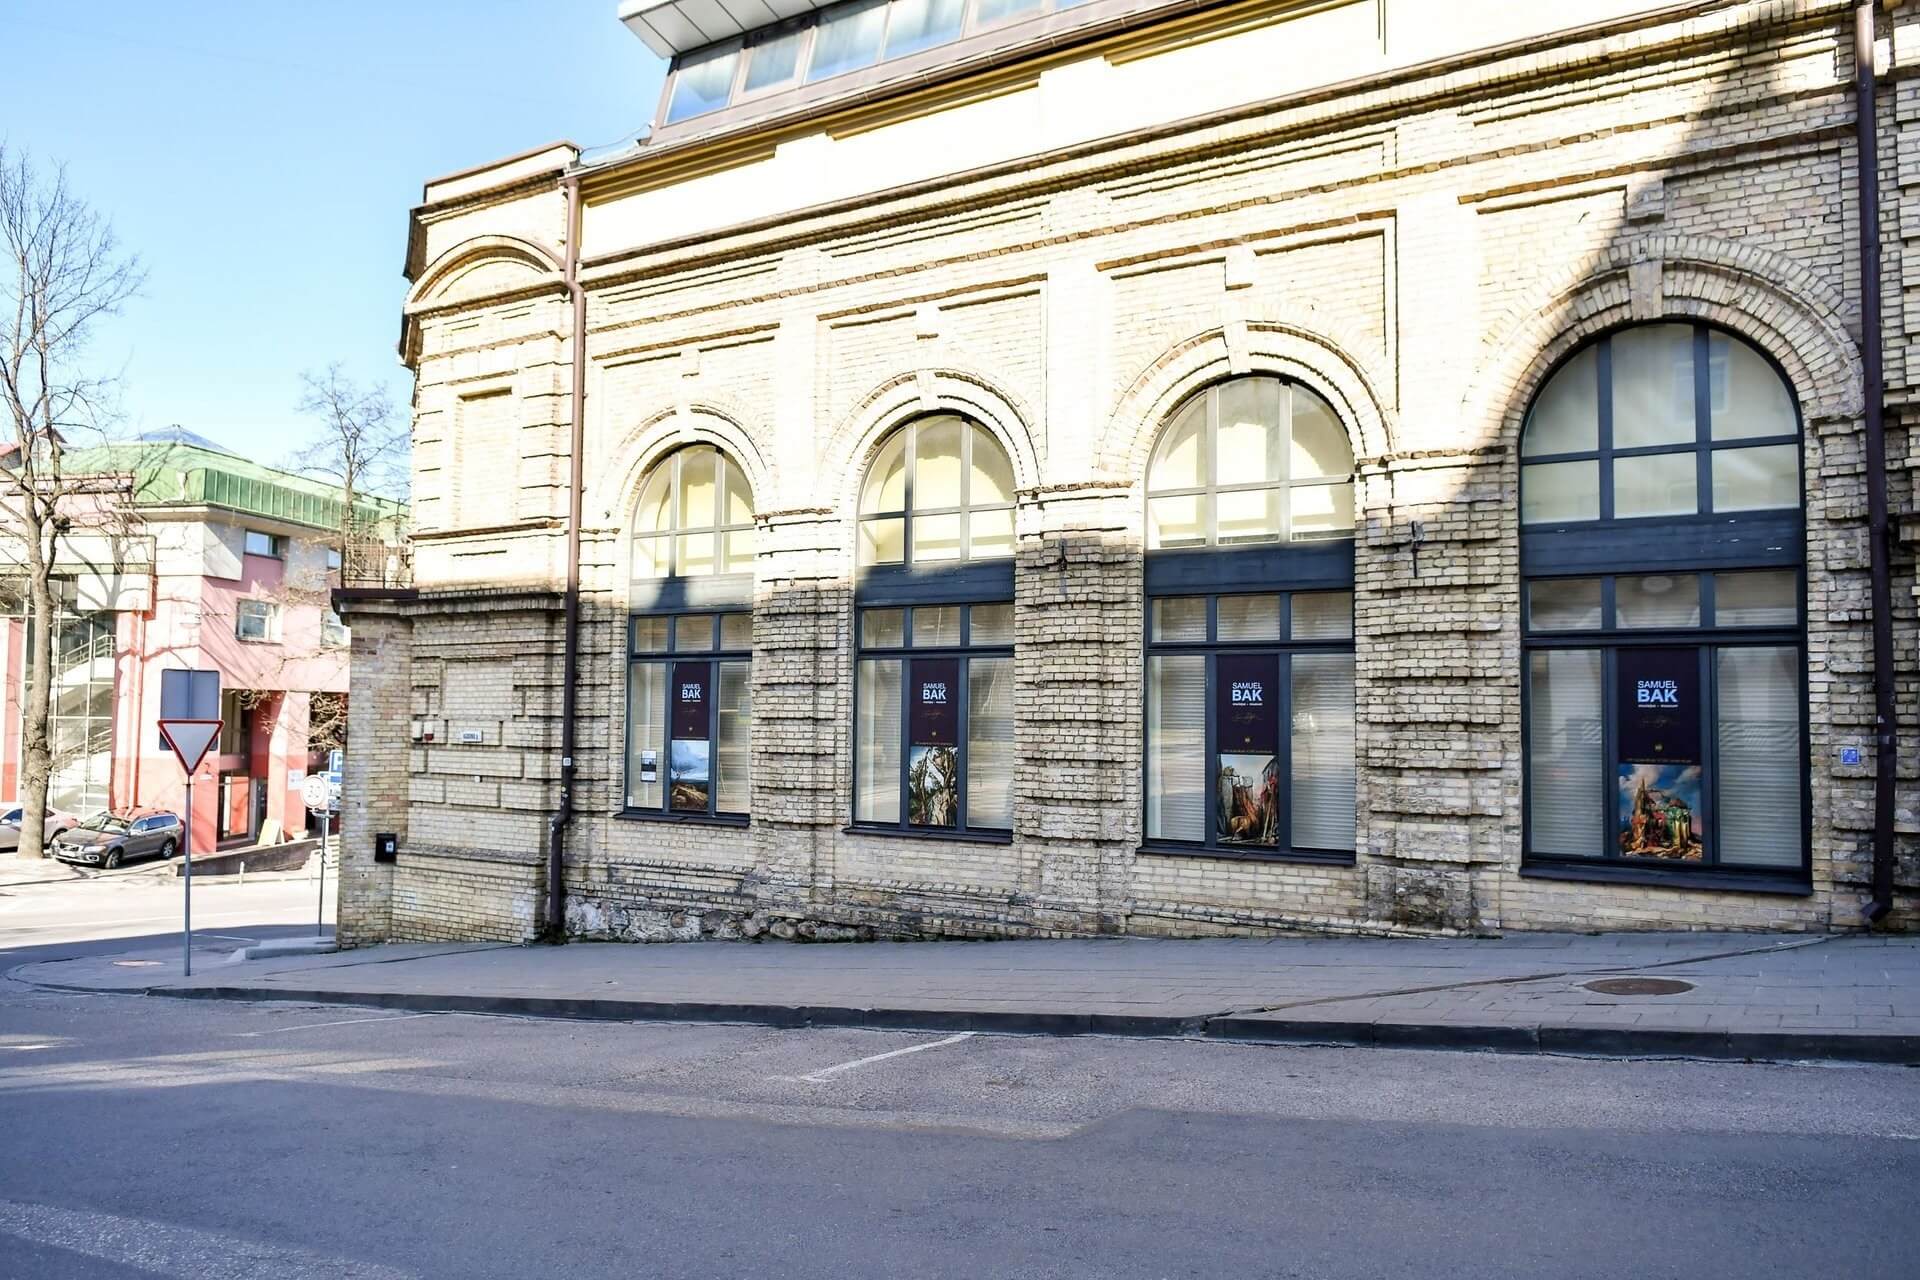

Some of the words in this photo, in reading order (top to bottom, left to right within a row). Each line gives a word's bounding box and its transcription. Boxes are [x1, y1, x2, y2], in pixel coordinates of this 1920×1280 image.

[1638, 680, 1677, 689] SAMUEL
[682, 689, 701, 699] BAK
[923, 689, 946, 700] BAK
[1232, 689, 1263, 702] BAK
[1637, 689, 1678, 702] BAK
